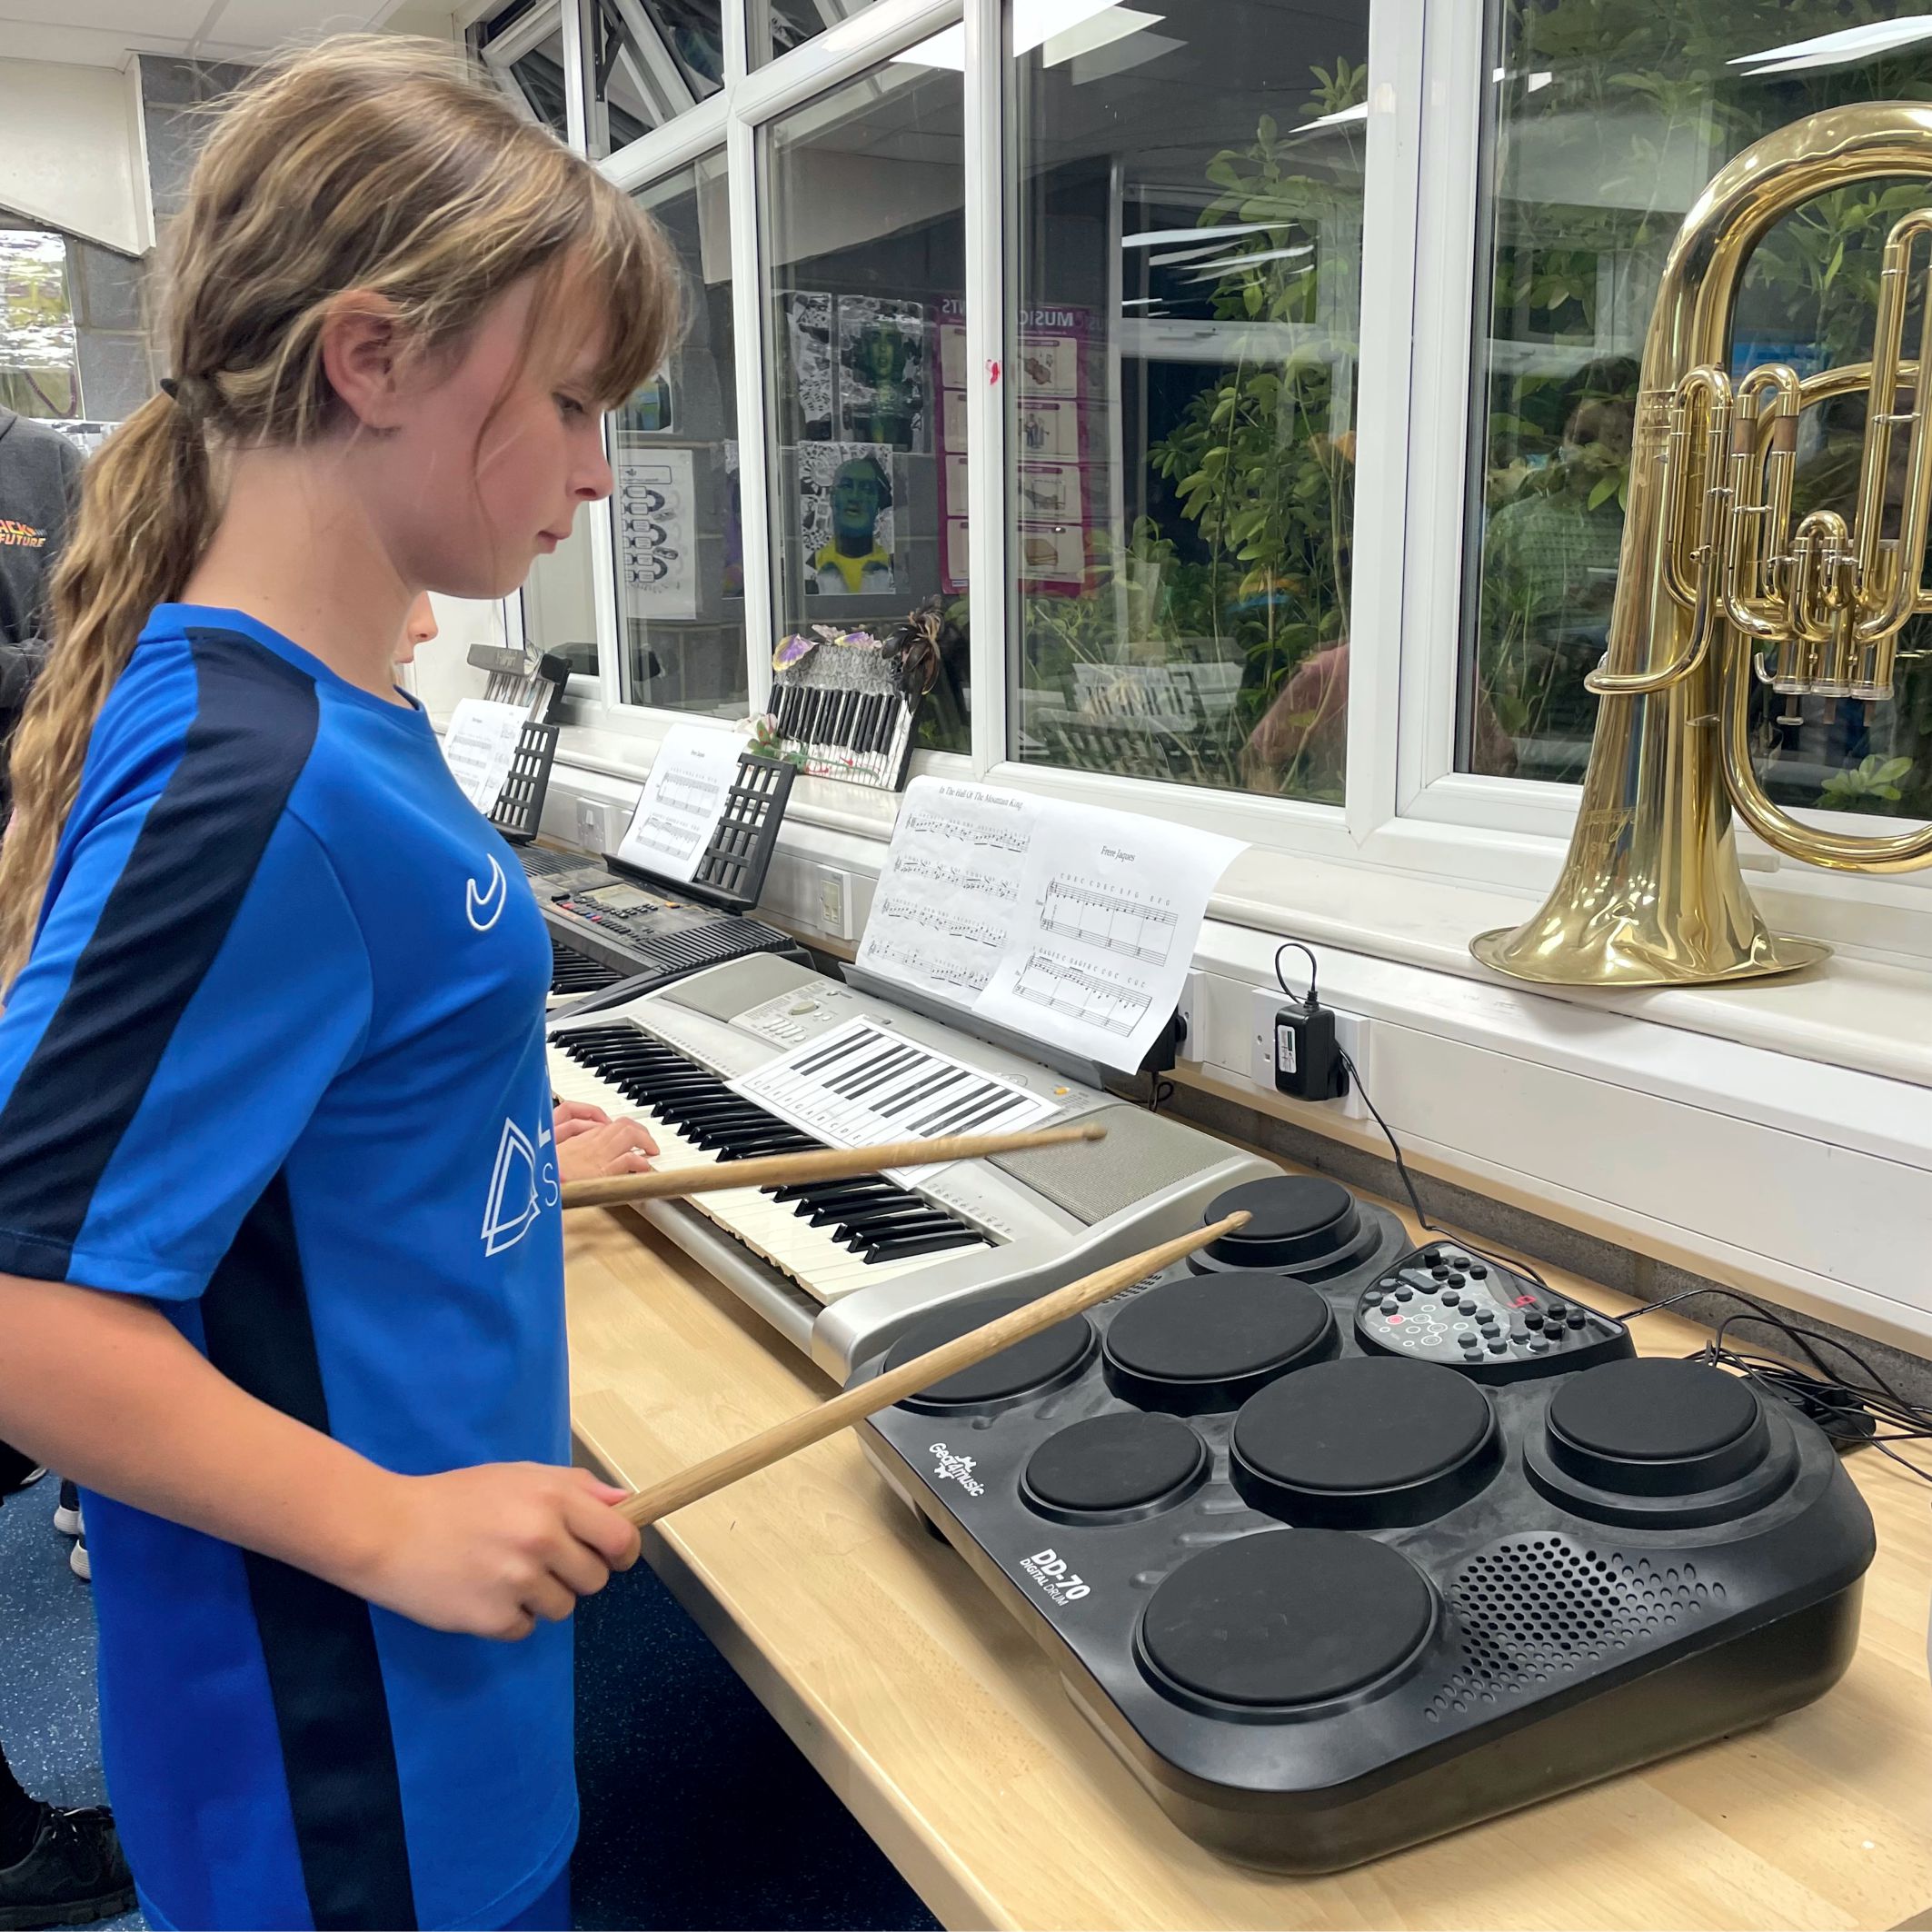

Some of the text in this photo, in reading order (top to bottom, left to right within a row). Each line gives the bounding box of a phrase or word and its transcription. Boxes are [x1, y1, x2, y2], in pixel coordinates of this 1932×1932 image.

[0, 519, 33, 536] ACK
[946, 786, 956, 796] The
[955, 788, 968, 798] Hall
[974, 792, 984, 801] The
[1009, 799, 1023, 812] King
[929, 1442, 985, 1497] Gear4music
[1019, 1558, 1070, 1607] DIGITAL DRUM
[1031, 1548, 1091, 1600] DD-70
